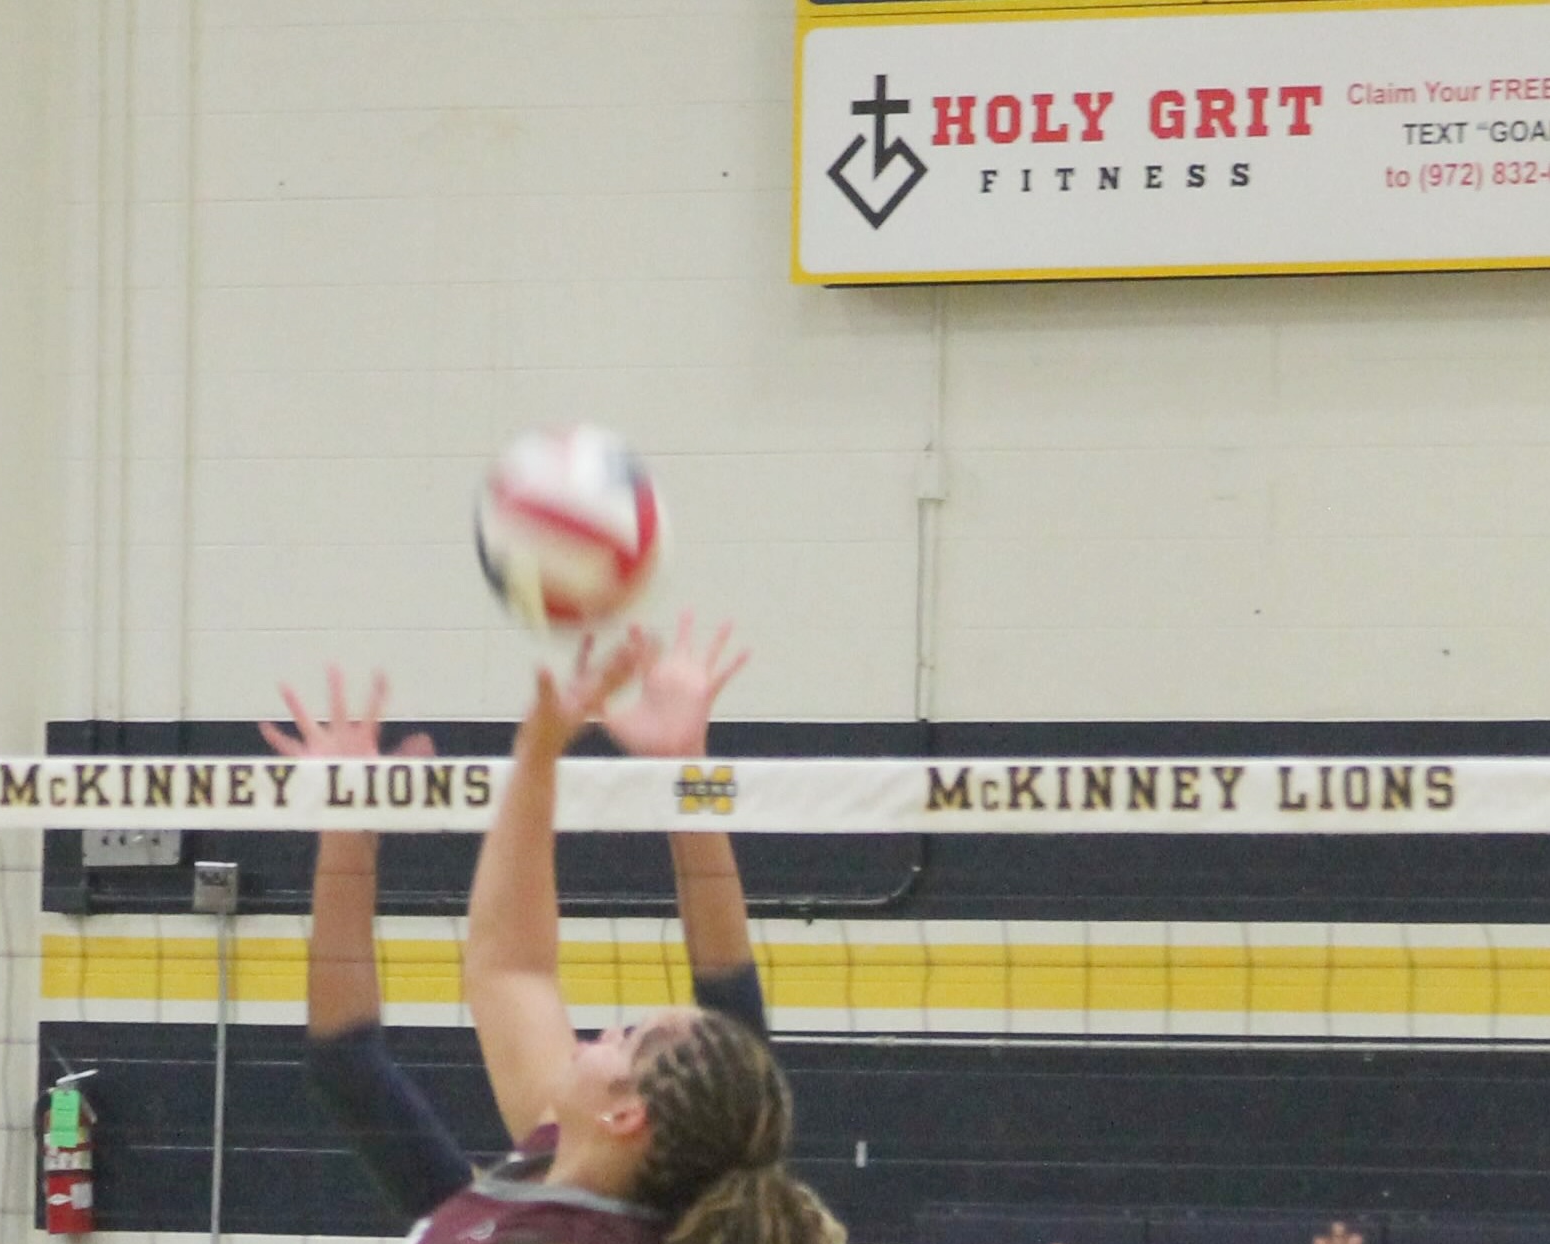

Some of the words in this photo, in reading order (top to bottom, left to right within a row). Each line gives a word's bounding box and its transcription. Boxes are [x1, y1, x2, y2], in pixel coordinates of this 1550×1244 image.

[1347, 83, 1417, 105] Claim
[1424, 80, 1482, 103] Your
[1489, 77, 1550, 100] FREE
[931, 92, 1114, 146] HOLY
[1149, 85, 1323, 139] GRIT
[1402, 121, 1469, 145] TEXT
[980, 162, 1250, 194] FITNESS
[1385, 166, 1411, 188] to
[1418, 162, 1483, 192] (972)
[1492, 160, 1550, 185] 832-
[326, 763, 492, 808] LIONS
[925, 765, 1246, 811] McKINNEY
[1276, 765, 1457, 811] LIONS
